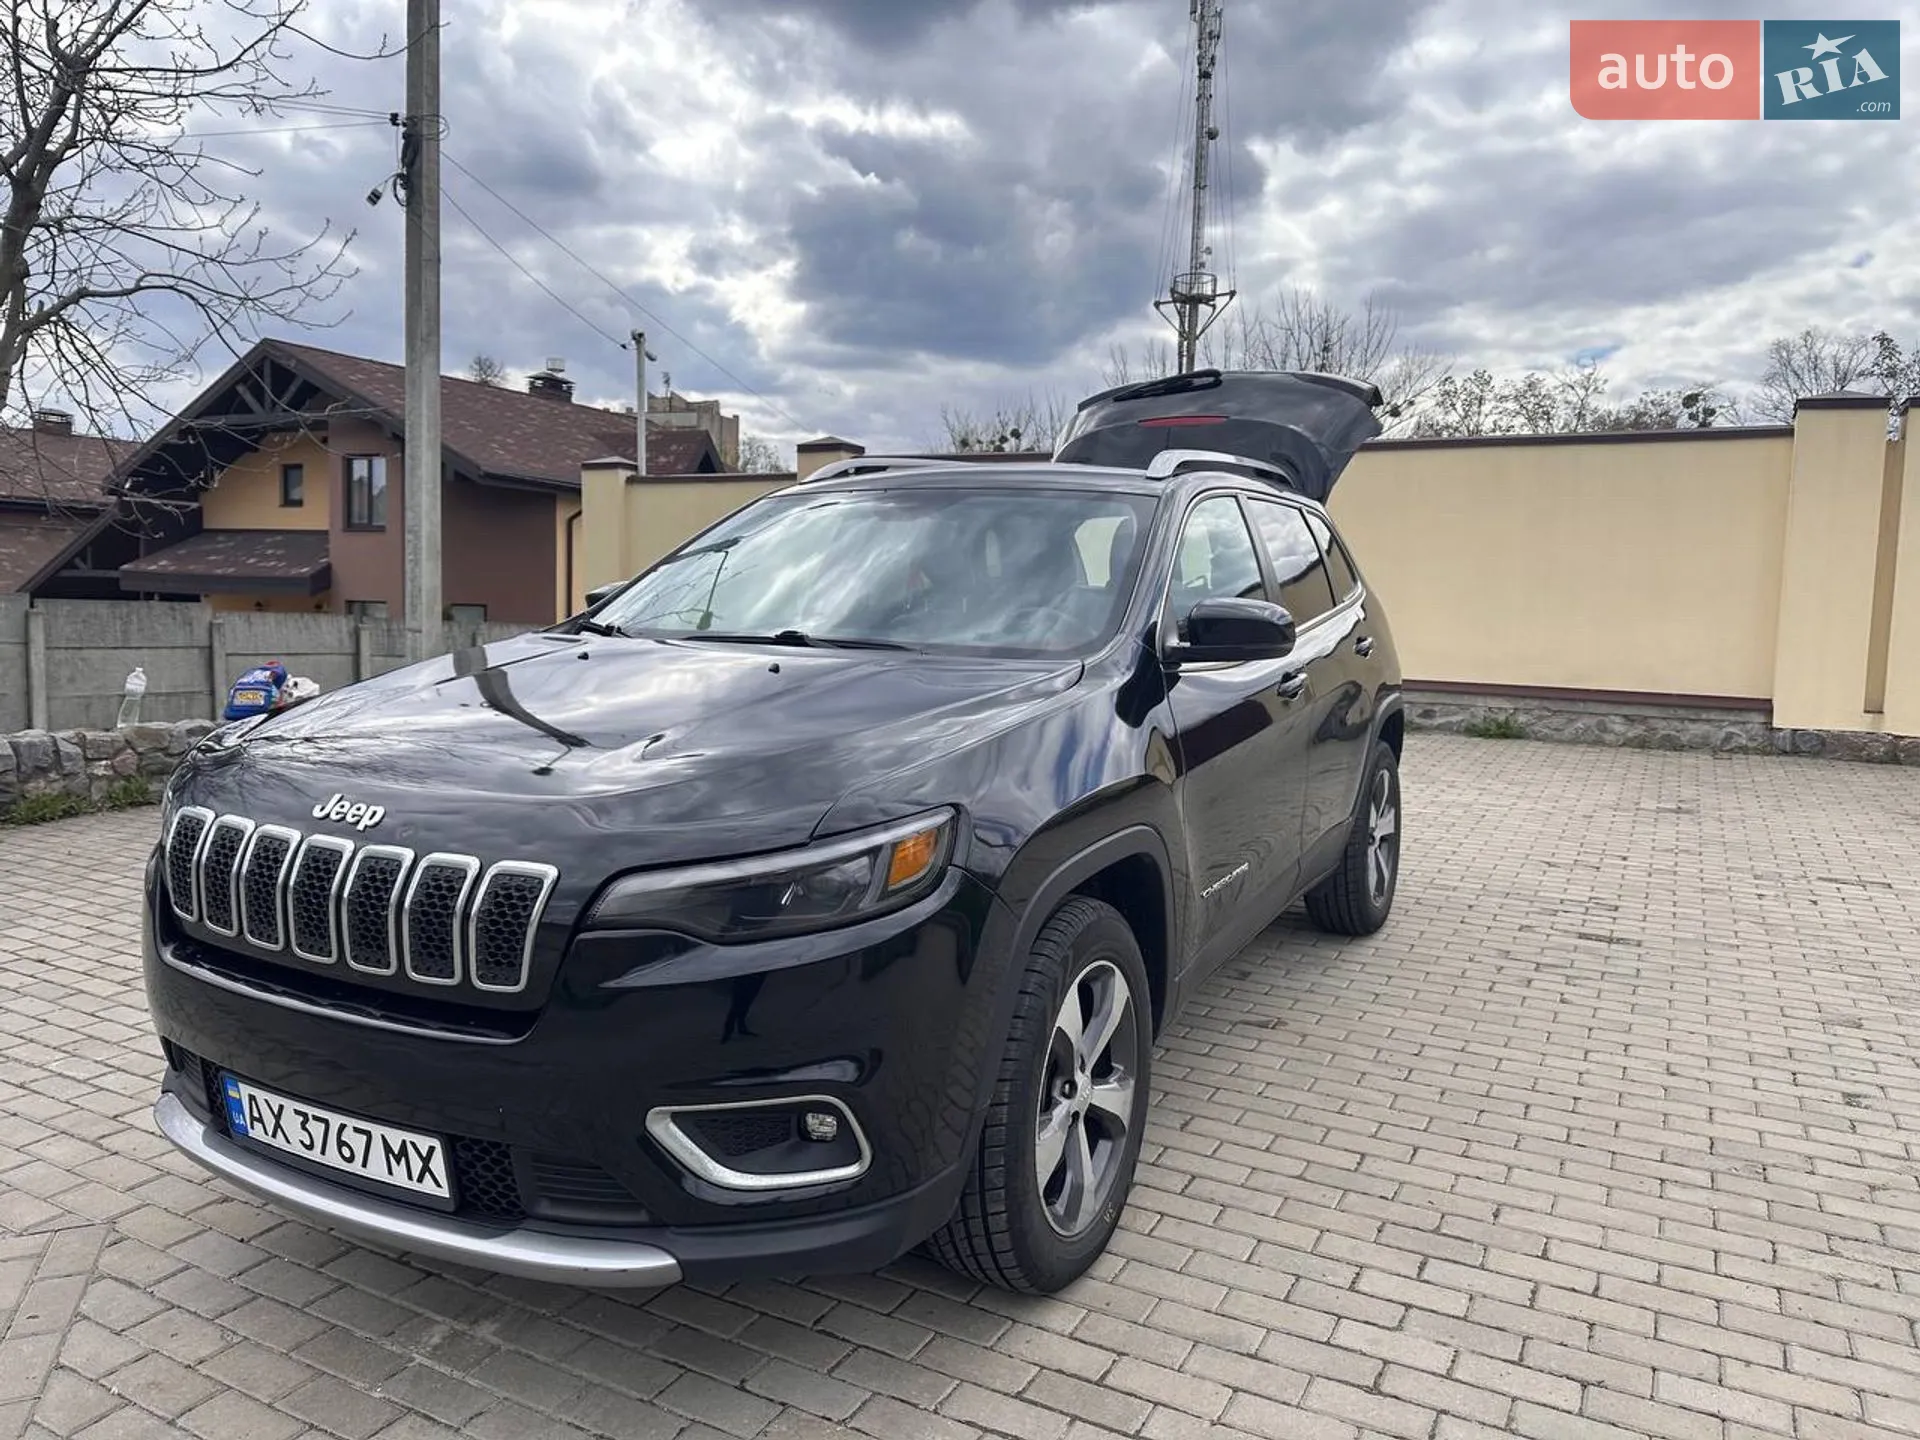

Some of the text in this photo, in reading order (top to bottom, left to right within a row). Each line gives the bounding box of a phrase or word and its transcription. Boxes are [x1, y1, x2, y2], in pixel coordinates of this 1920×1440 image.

[312, 793, 385, 831] Jeep
[232, 1111, 246, 1127] UA
[247, 1092, 443, 1189] AX 3767 MX
